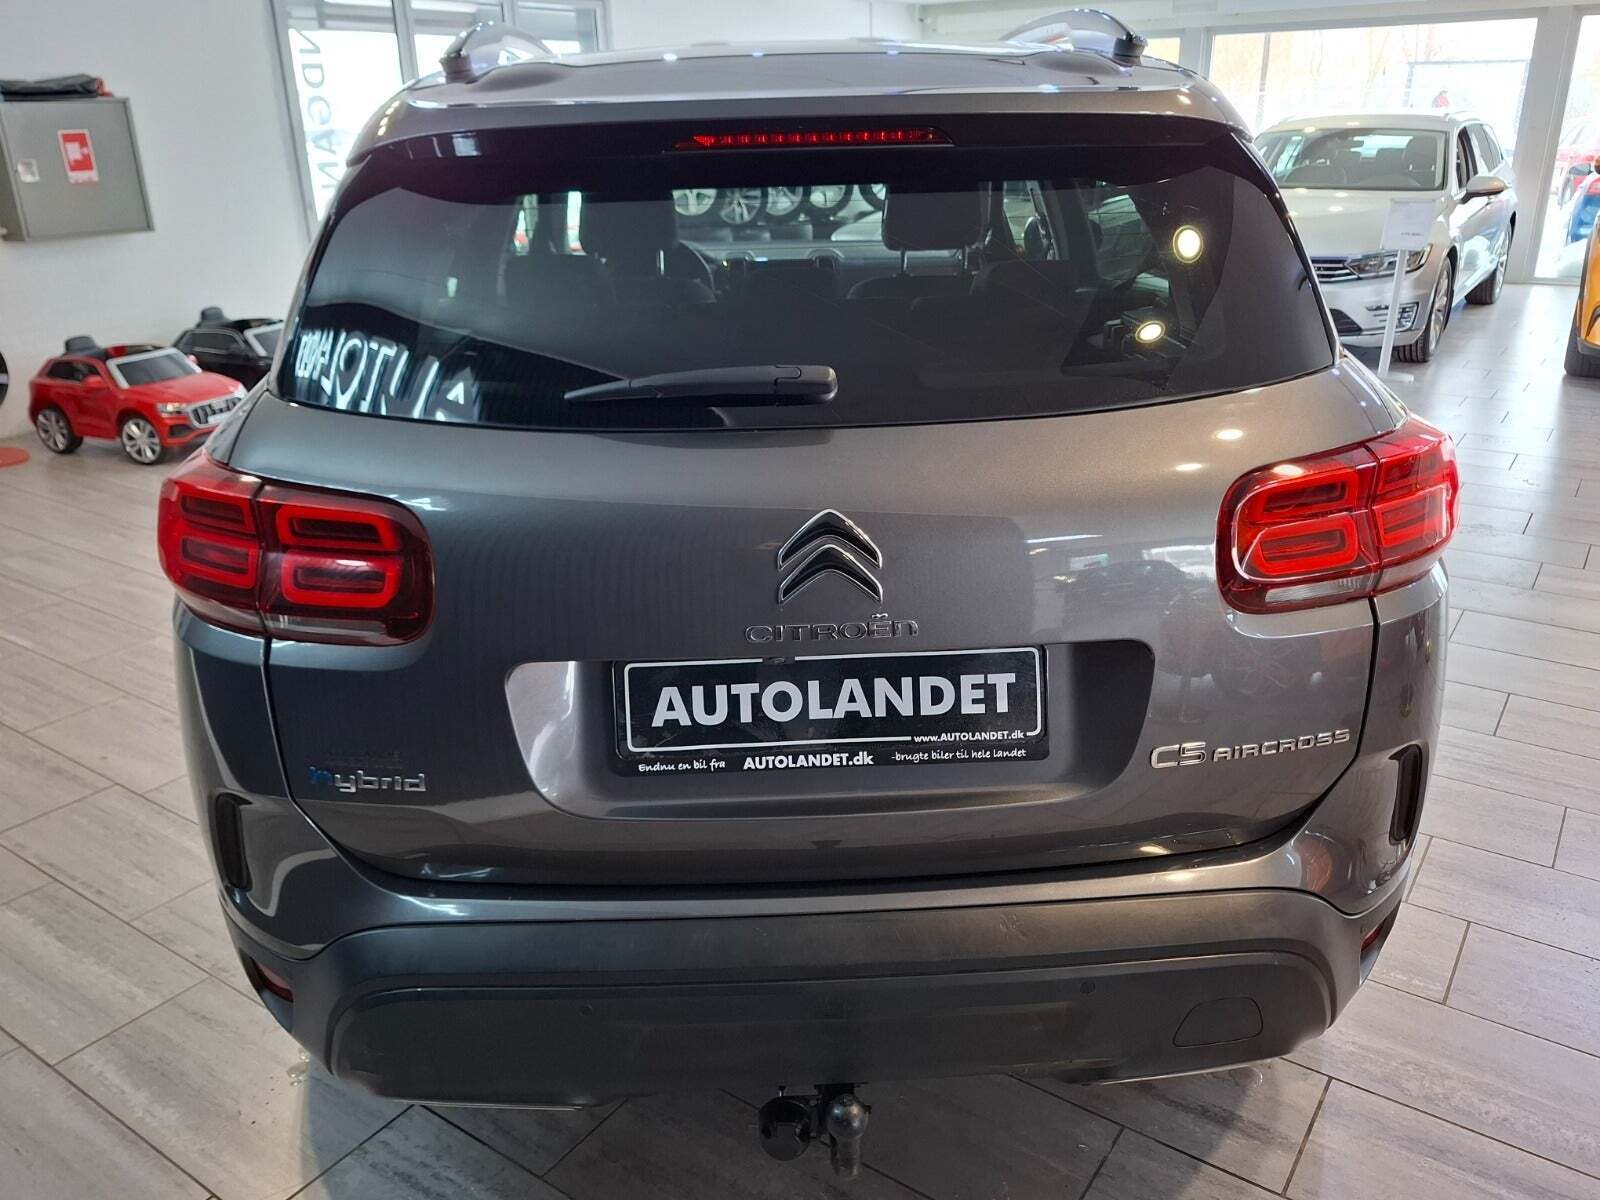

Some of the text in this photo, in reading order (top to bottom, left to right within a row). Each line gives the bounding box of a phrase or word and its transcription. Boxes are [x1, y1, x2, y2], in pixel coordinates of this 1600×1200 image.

[651, 672, 1017, 728] AUTOLANDET
[914, 730, 1025, 743] www.AUTOLANDET.dk
[1150, 728, 1350, 769] C5 AIRCROSS
[638, 762, 676, 773] Endnu
[693, 759, 708, 770] bil
[710, 759, 726, 772] fra
[743, 751, 874, 771] AUTOLANDET.dk
[931, 749, 954, 761] biler
[956, 750, 969, 760] til
[971, 750, 991, 759] hele
[993, 748, 1027, 758] landet
[307, 766, 427, 793] hybrid
